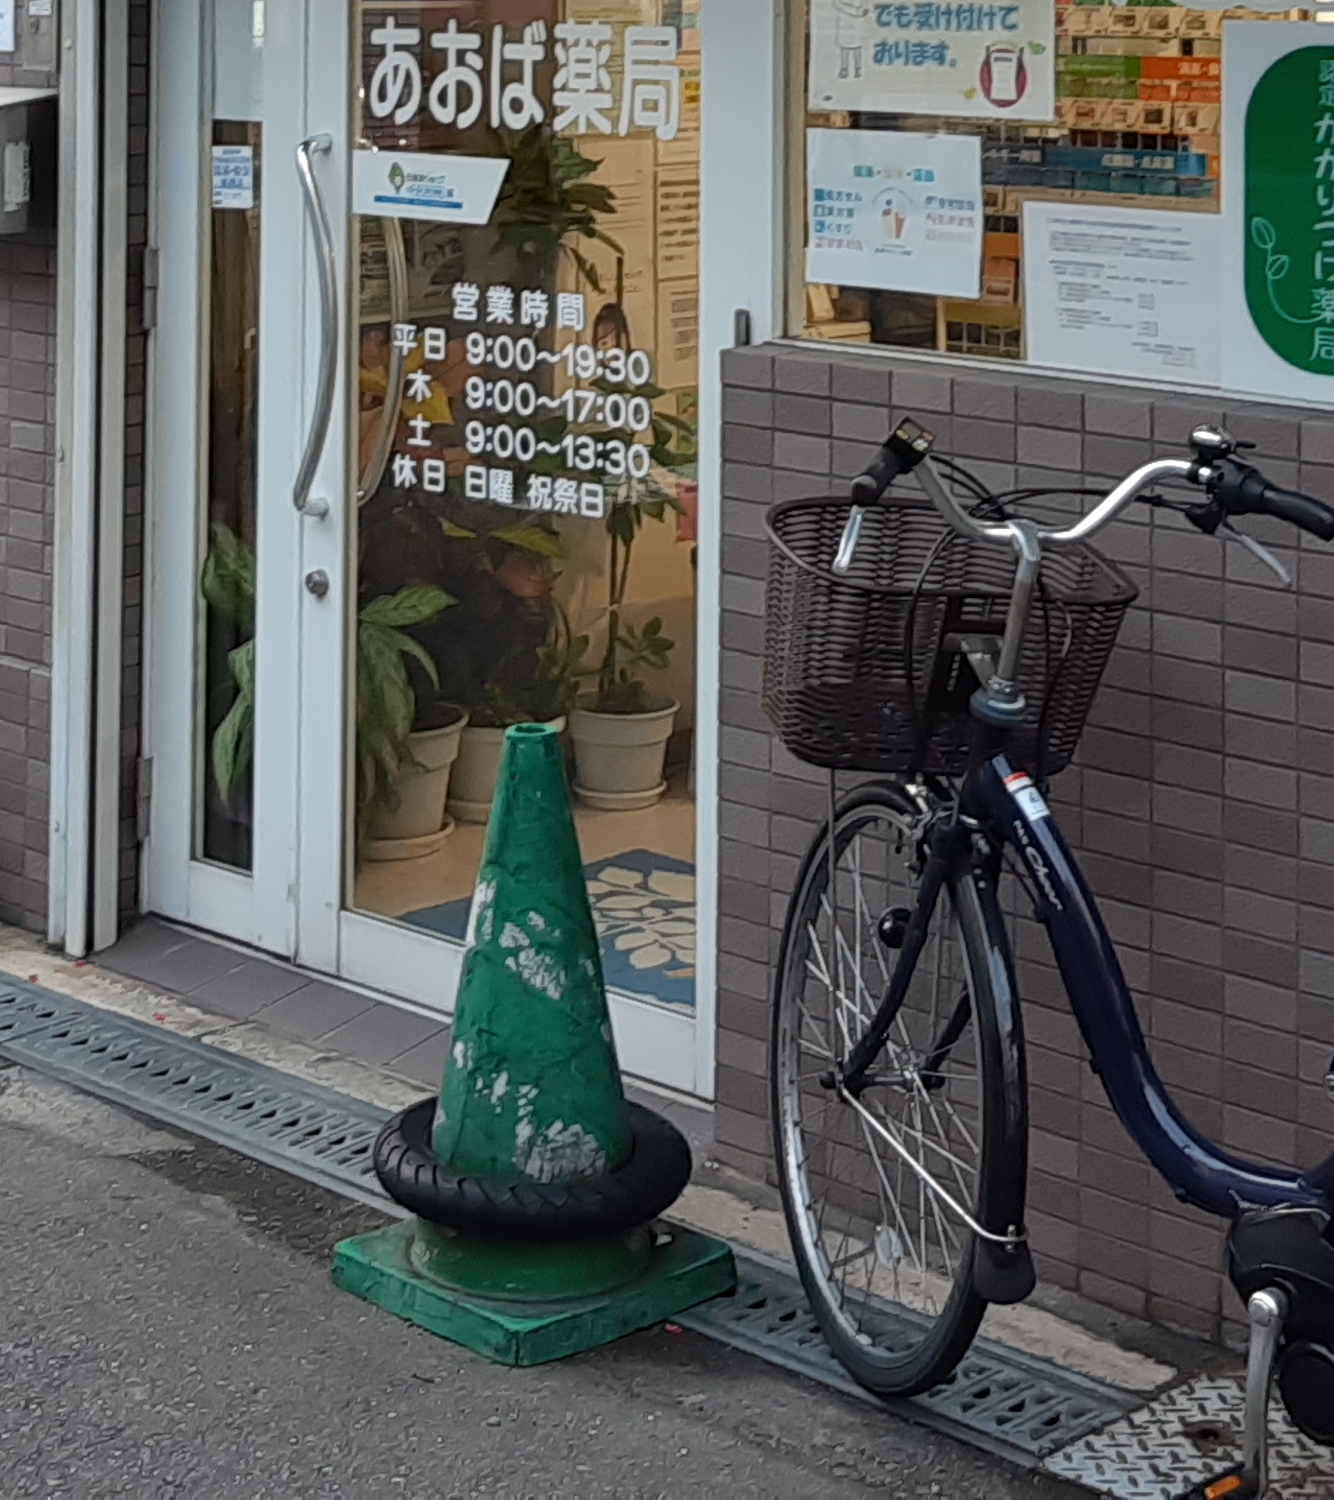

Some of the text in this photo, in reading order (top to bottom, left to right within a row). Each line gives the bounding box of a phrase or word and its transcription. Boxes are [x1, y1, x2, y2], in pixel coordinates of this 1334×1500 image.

[873, 2, 1020, 32] でも受け付けて
[873, 39, 958, 68] おります。
[370, 15, 681, 141] あおば薬局
[452, 282, 585, 331] 営業時間
[393, 323, 446, 360] 平日
[407, 369, 432, 403] 木
[407, 413, 432, 447] 土
[393, 453, 604, 518] 休日 日曜 祝祭日
